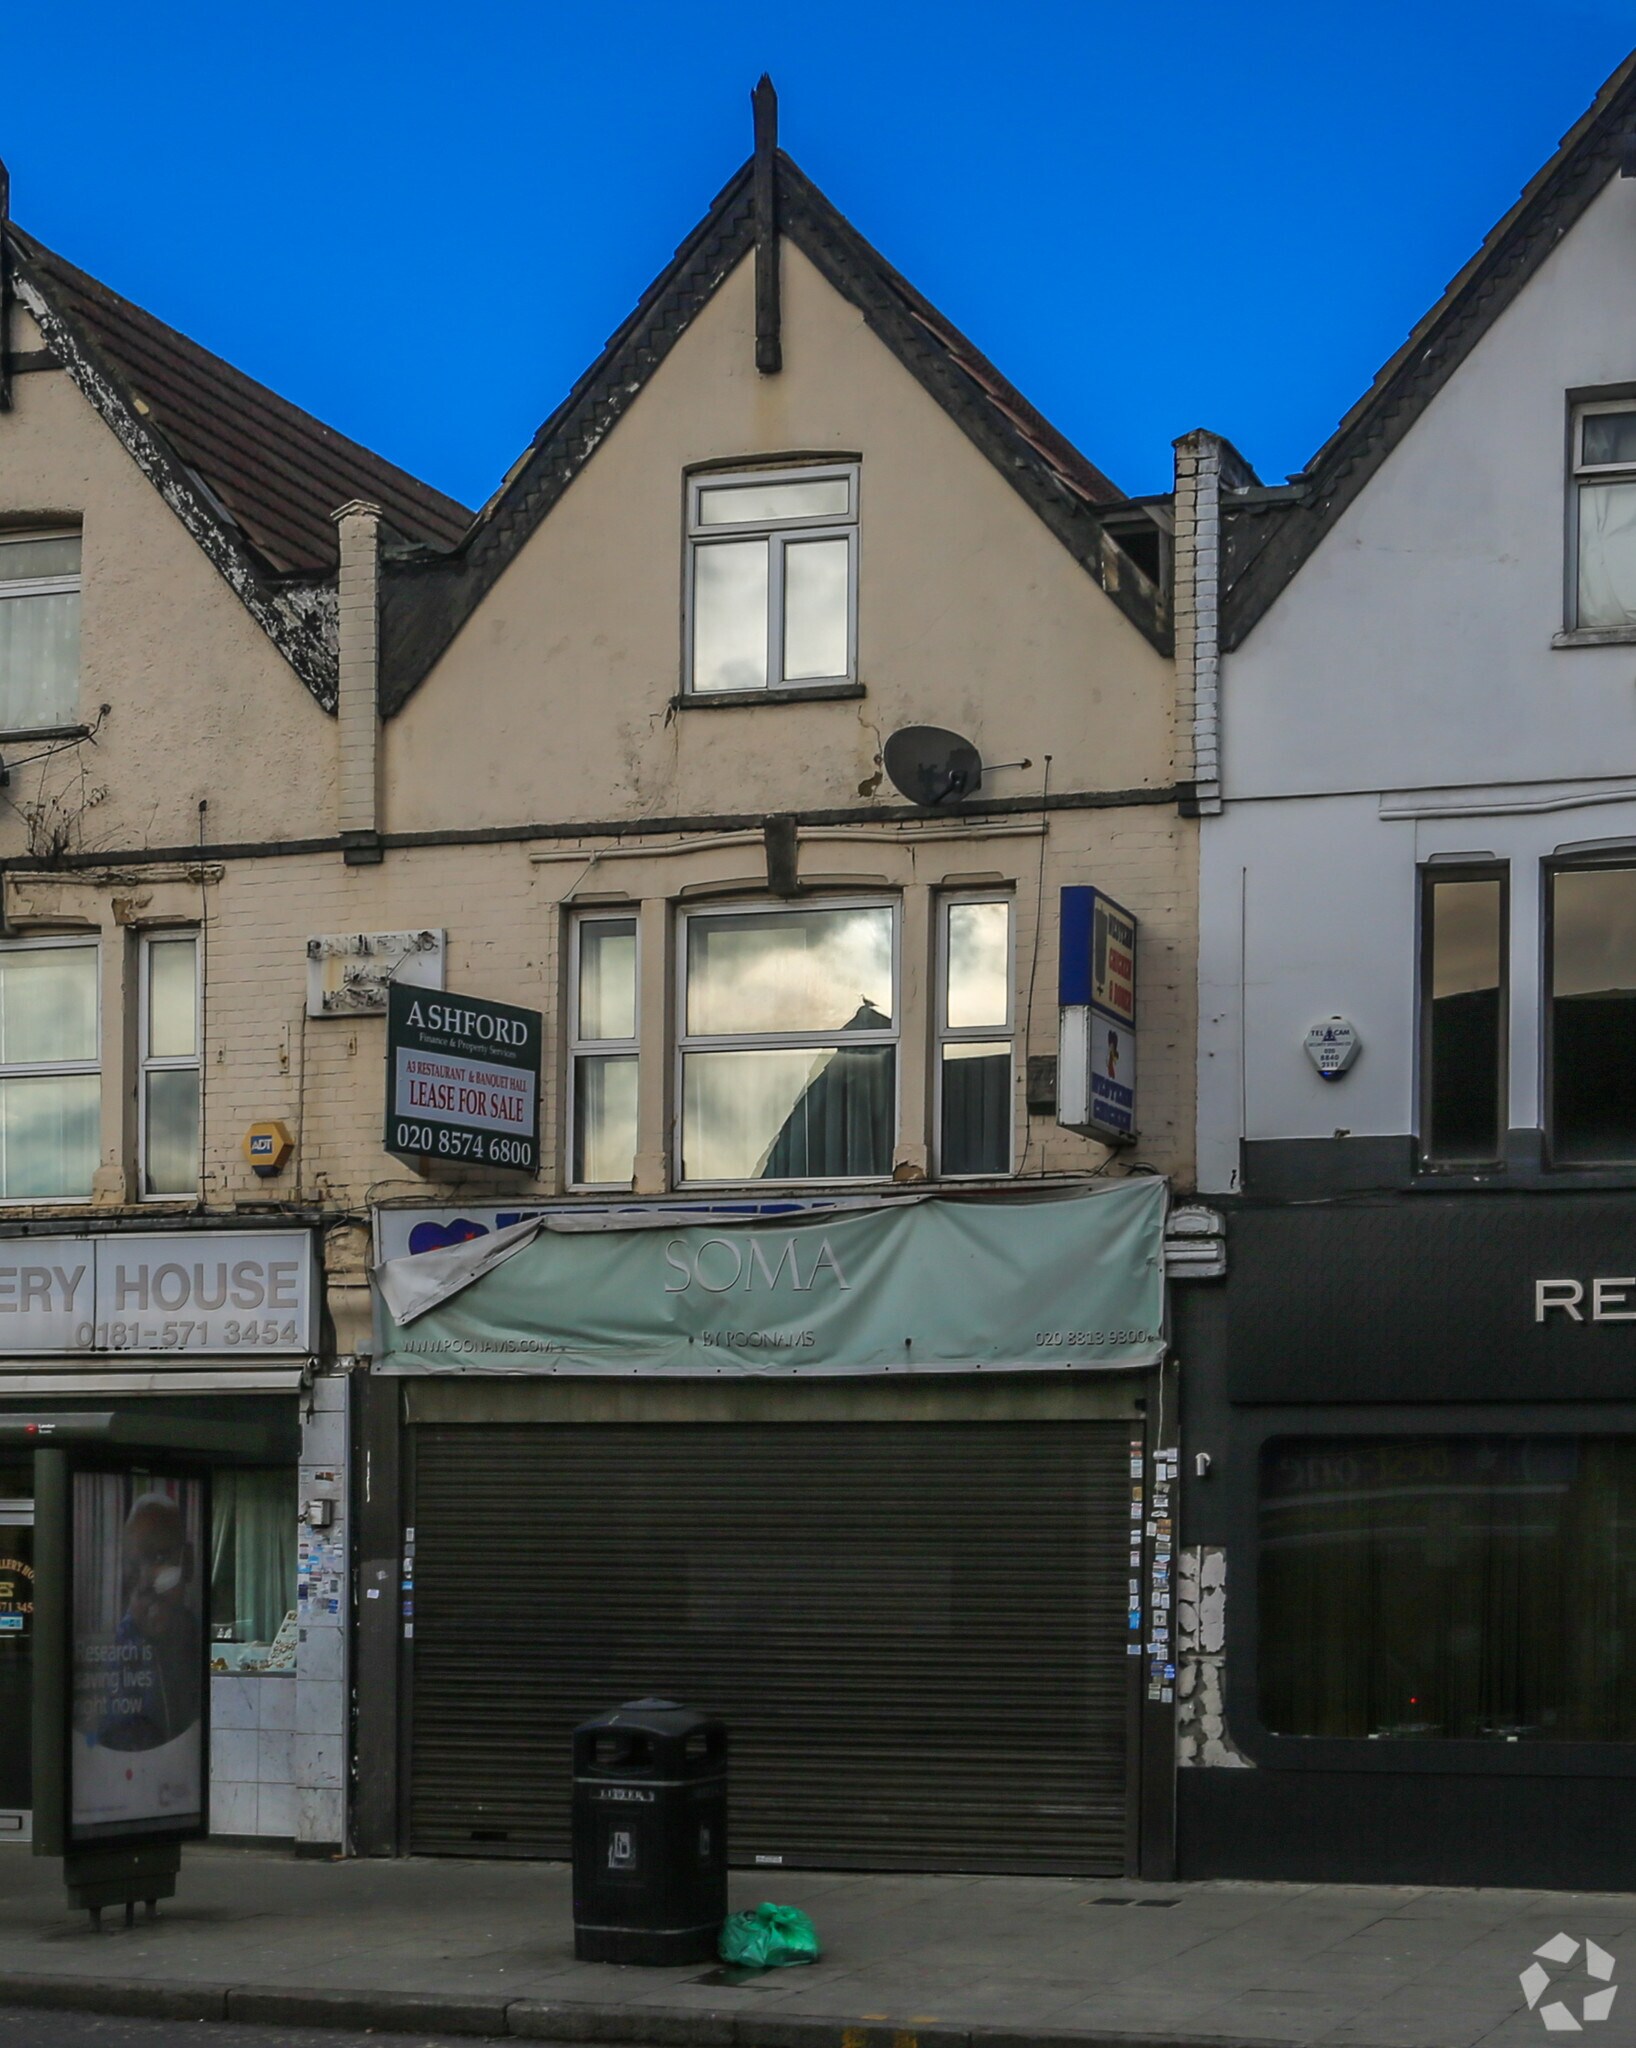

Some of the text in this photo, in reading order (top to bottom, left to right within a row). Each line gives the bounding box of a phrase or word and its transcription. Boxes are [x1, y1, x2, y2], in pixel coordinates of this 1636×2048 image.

[406, 1001, 528, 1046] ASHFORD
[419, 1032, 517, 1058] Finance & Property Services
[406, 1060, 528, 1092] A3 RESTAURANT & BANQUET HALL
[410, 1080, 525, 1123] LEASE FOR SALE
[251, 1138, 273, 1151] ADT
[397, 1123, 532, 1166] 020 8574 6800
[664, 1237, 853, 1293] SOMA
[115, 1260, 300, 1312] HOUSE
[1534, 1277, 1636, 1322] RE
[75, 1319, 298, 1348] 0181-571 3454
[702, 1329, 816, 1348] BY POONAMS
[1034, 1330, 1064, 1347] 020
[142, 1643, 153, 1661] is
[123, 1665, 153, 1688] lives
[111, 1697, 143, 1715] now
